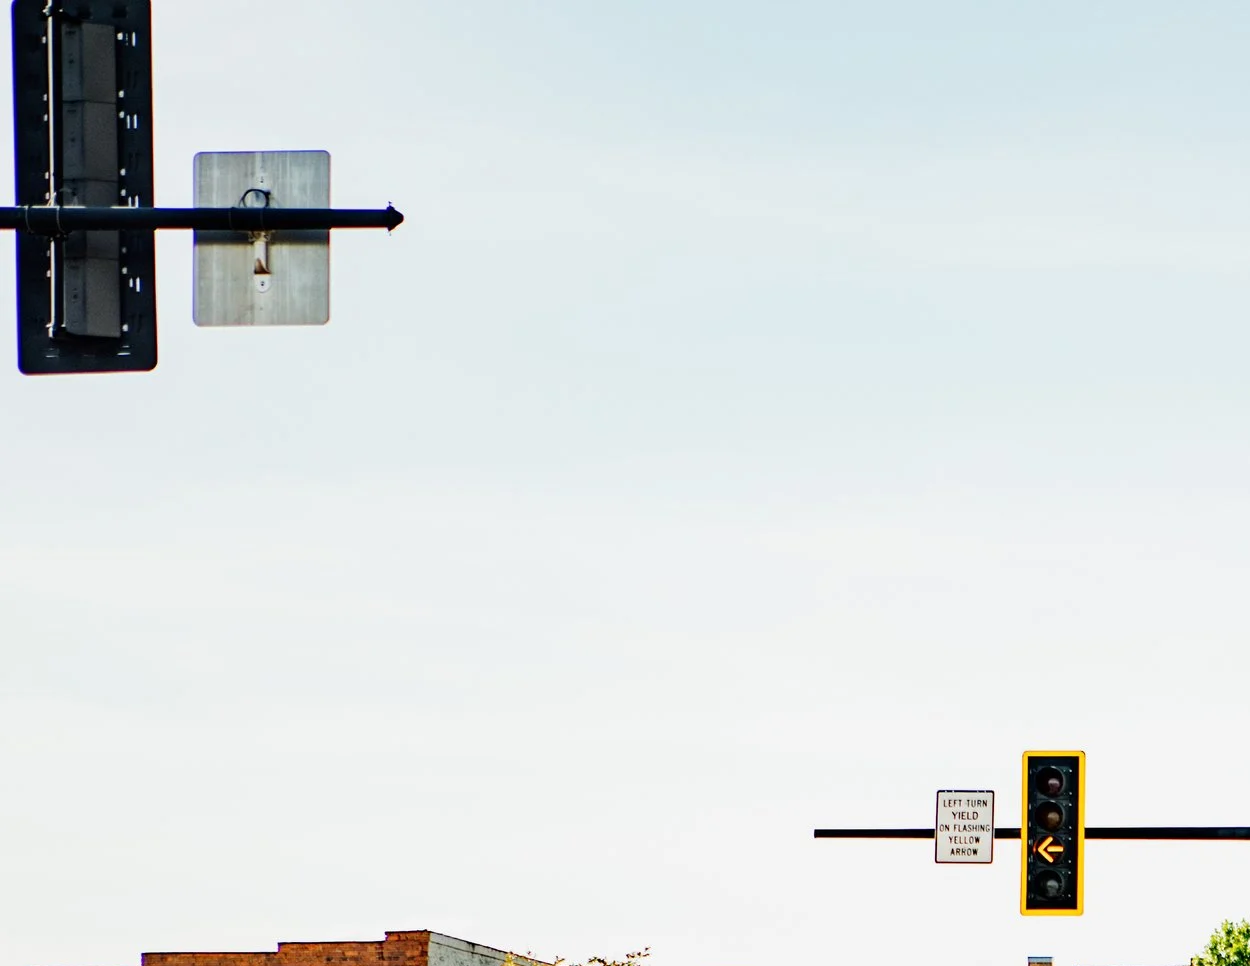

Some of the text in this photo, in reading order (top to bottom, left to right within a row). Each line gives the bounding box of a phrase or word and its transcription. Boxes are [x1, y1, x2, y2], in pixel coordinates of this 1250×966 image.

[943, 799, 988, 807] LEFT TURN
[951, 811, 979, 820] YIELD
[939, 824, 991, 832] ON FLASHING
[948, 835, 981, 844] YELLOW
[950, 848, 979, 856] ARROW
